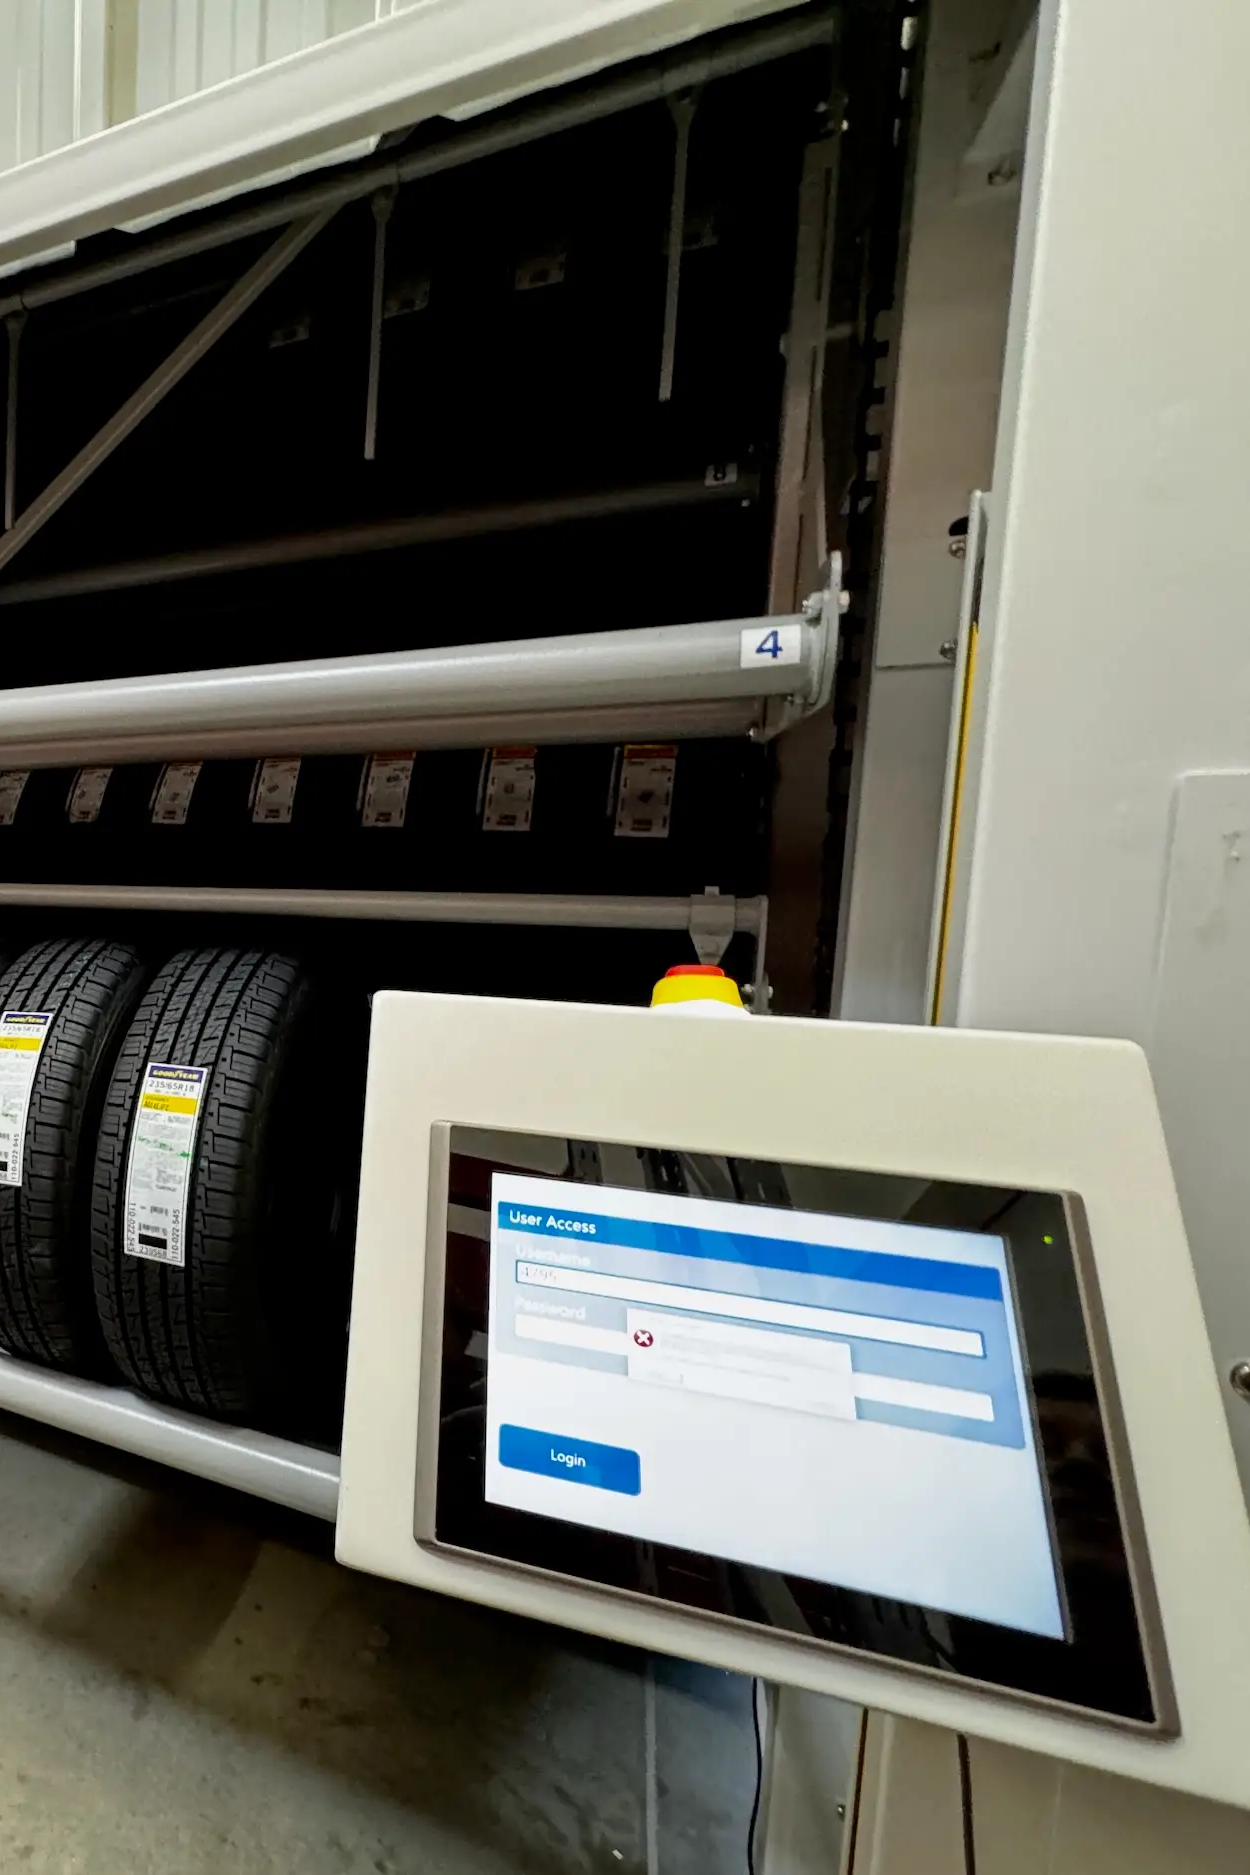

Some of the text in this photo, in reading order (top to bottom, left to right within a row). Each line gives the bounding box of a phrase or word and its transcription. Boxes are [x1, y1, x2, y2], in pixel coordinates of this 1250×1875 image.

[755, 630, 783, 659] 4
[153, 1069, 200, 1080] GOODYEAR
[149, 1080, 196, 1093] 235/65R18
[509, 1209, 597, 1235] User Access
[515, 1244, 591, 1267] Username
[515, 1294, 586, 1320] Password
[550, 1448, 586, 1468] Login
